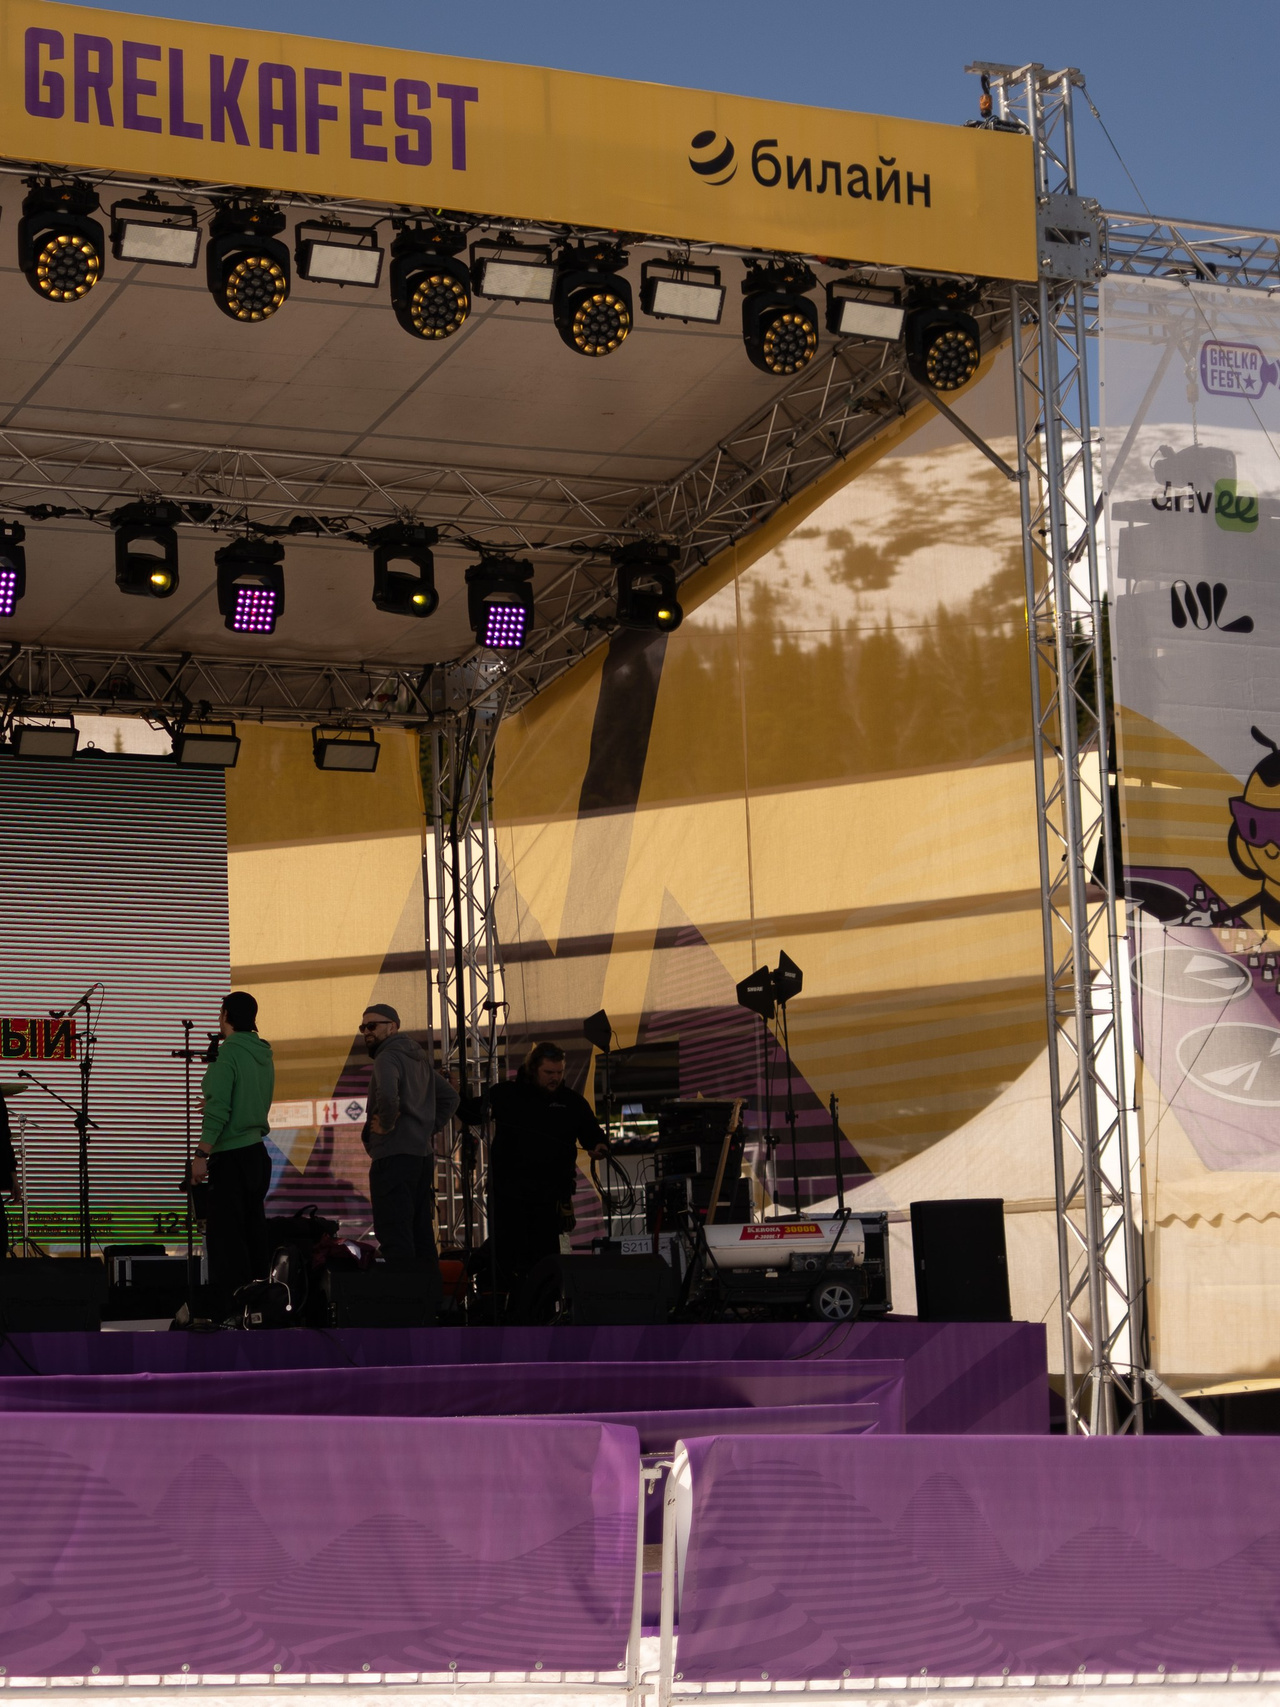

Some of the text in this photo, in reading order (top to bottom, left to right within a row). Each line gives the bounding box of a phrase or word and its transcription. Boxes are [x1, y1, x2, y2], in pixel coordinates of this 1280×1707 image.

[24, 26, 479, 171] GRELKAFEST
[751, 139, 931, 208] билайн
[1210, 348, 1258, 370] GRELKA
[1210, 369, 1242, 389] FEST
[784, 1225, 816, 1233] 30000
[622, 1241, 649, 1253] S211
